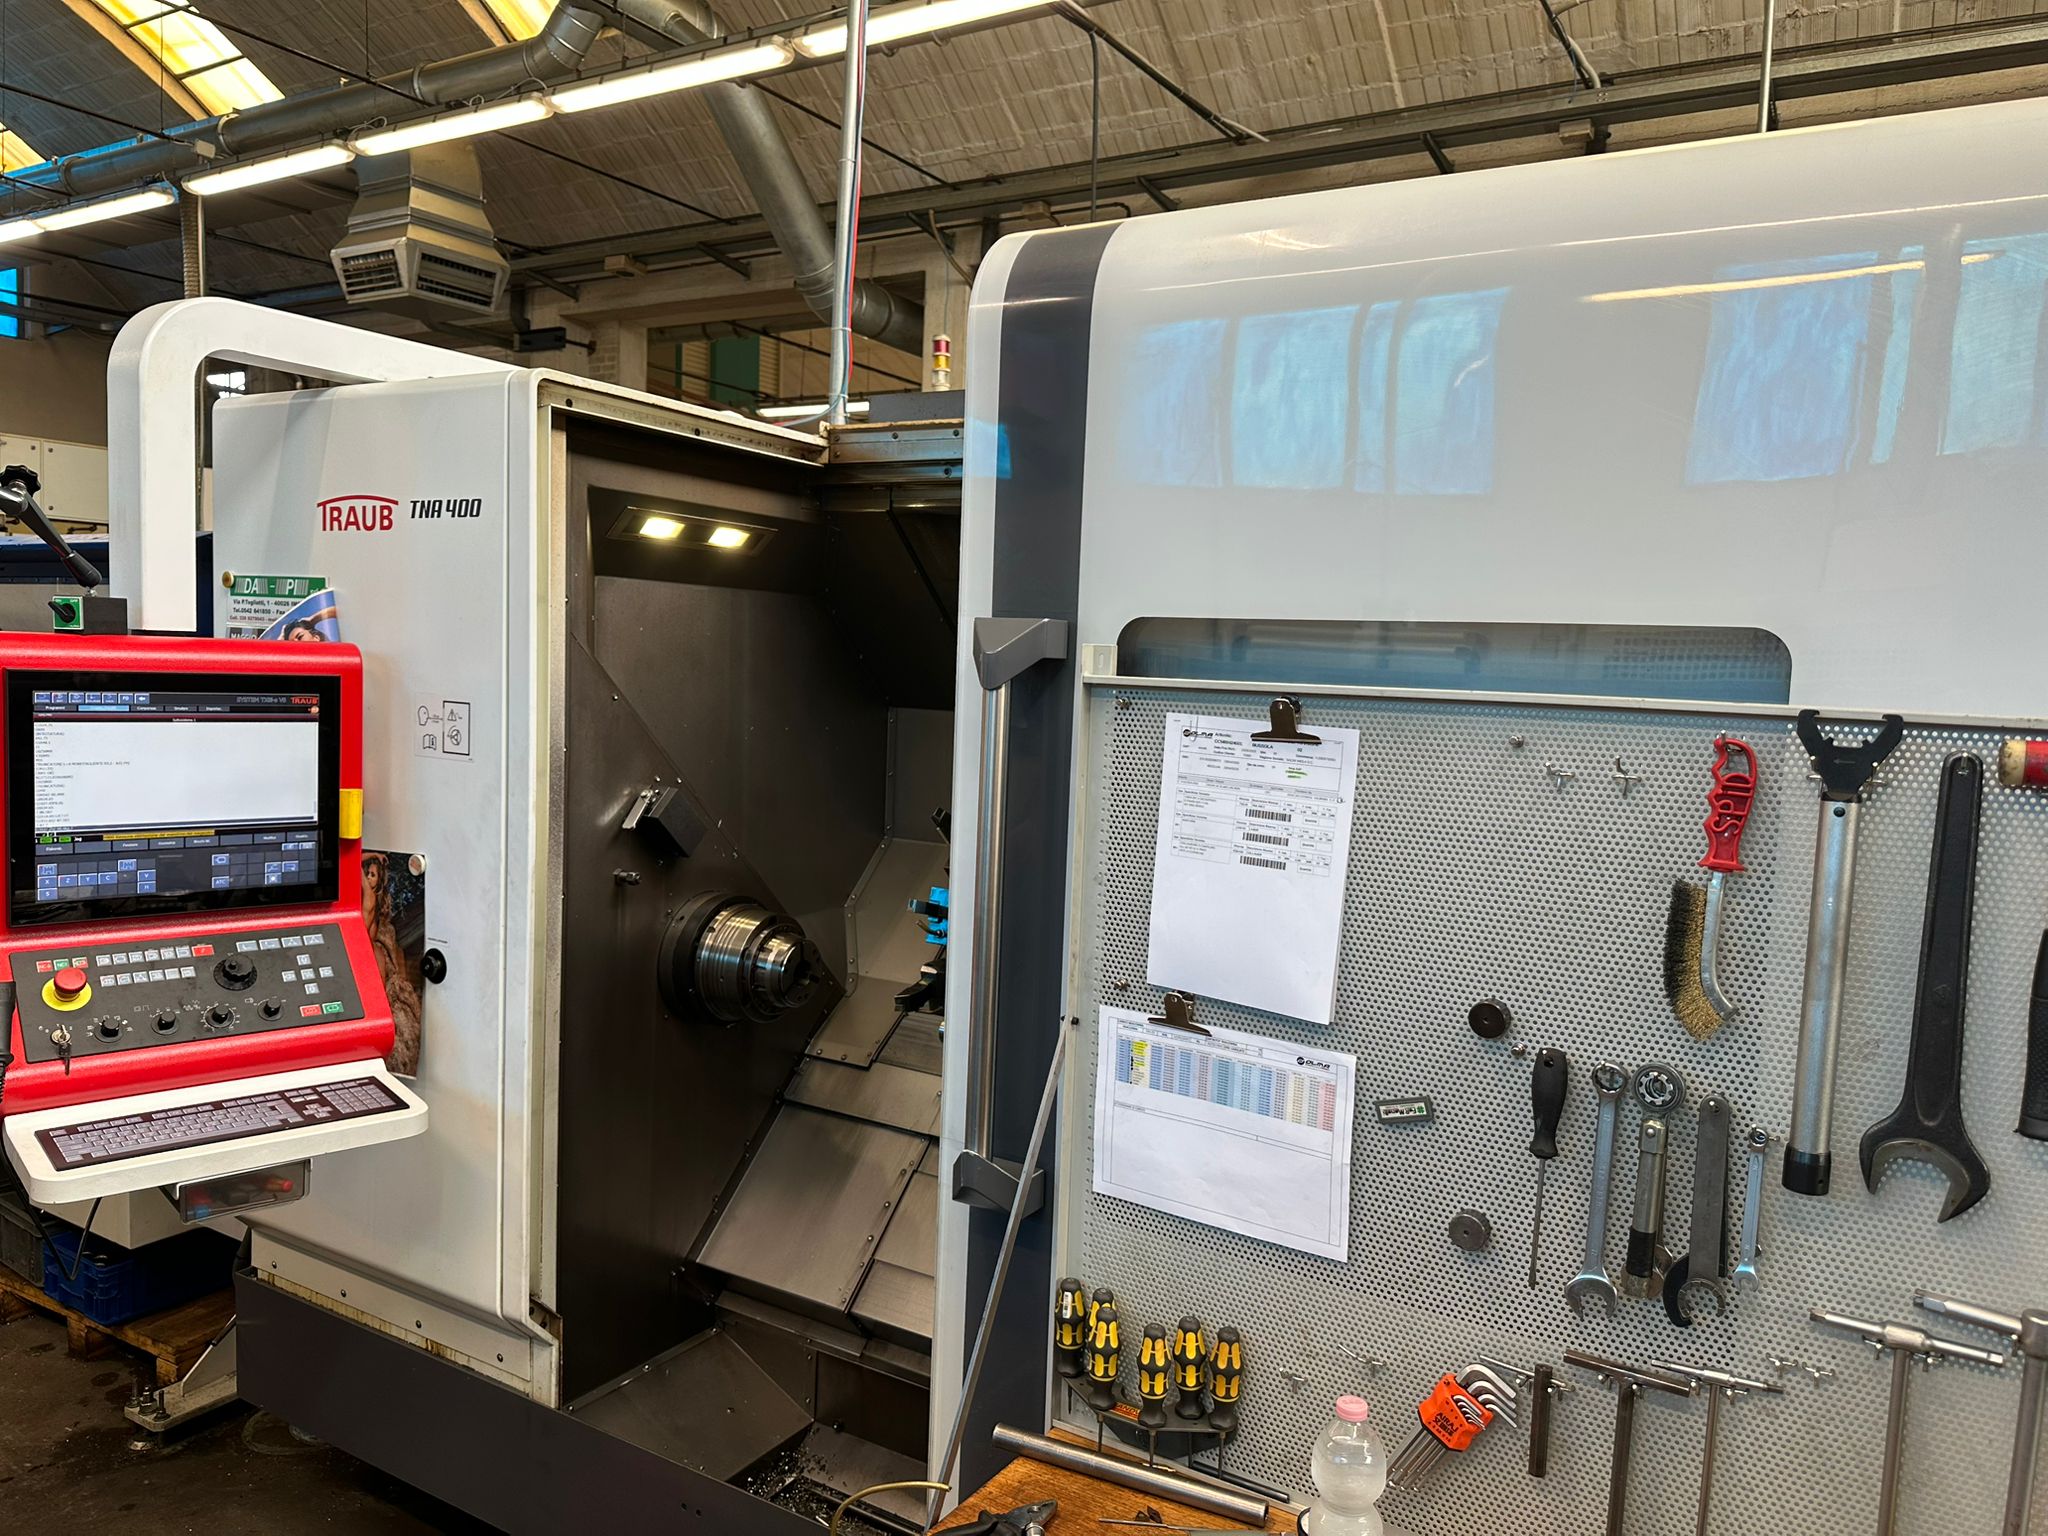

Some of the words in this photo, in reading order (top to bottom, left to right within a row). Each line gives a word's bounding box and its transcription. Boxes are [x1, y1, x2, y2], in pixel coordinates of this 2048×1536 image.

[316, 494, 399, 532] TRAUB
[410, 500, 442, 519] TNA
[446, 498, 482, 518] 400
[1711, 772, 1753, 835] SPID
